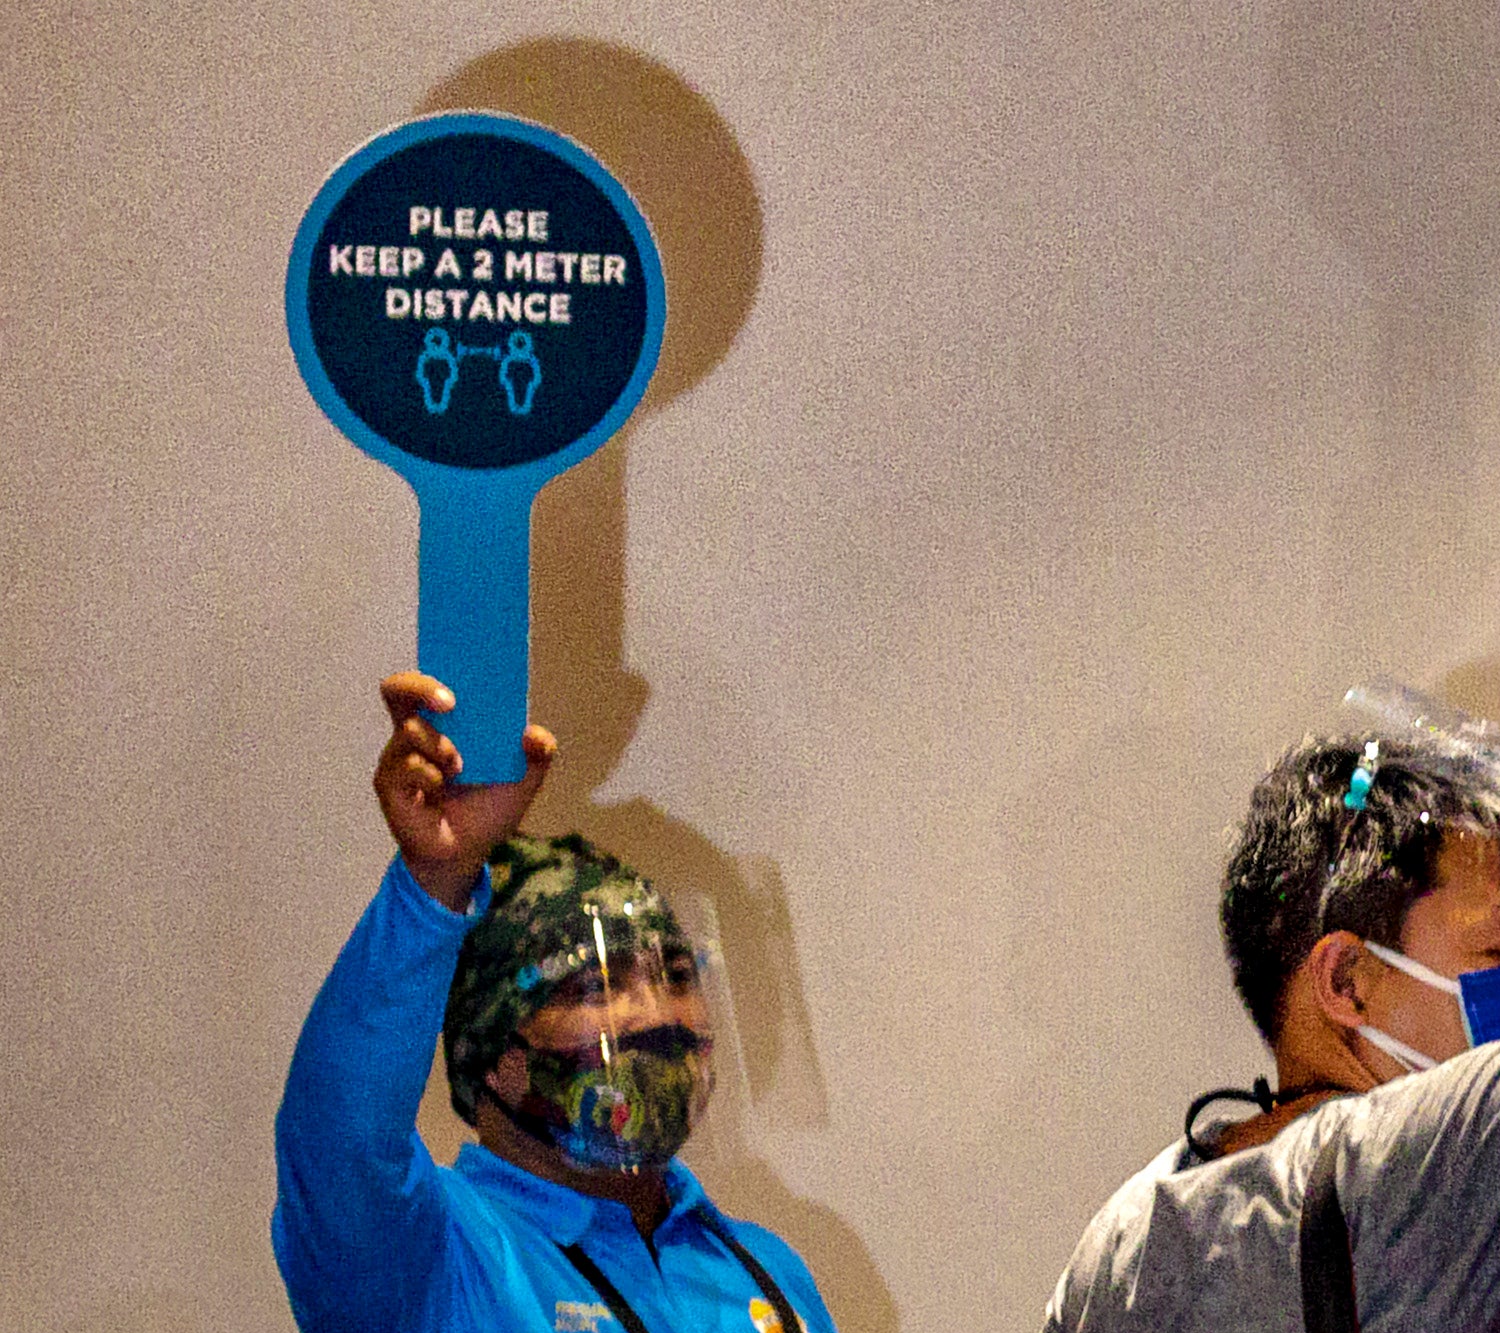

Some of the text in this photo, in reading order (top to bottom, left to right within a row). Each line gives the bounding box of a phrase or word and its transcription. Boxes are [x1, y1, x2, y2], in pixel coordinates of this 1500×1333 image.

[409, 206, 549, 241] PLEASE
[329, 245, 626, 284] KEEP A 2 METER
[385, 287, 572, 324] DISTANCE
